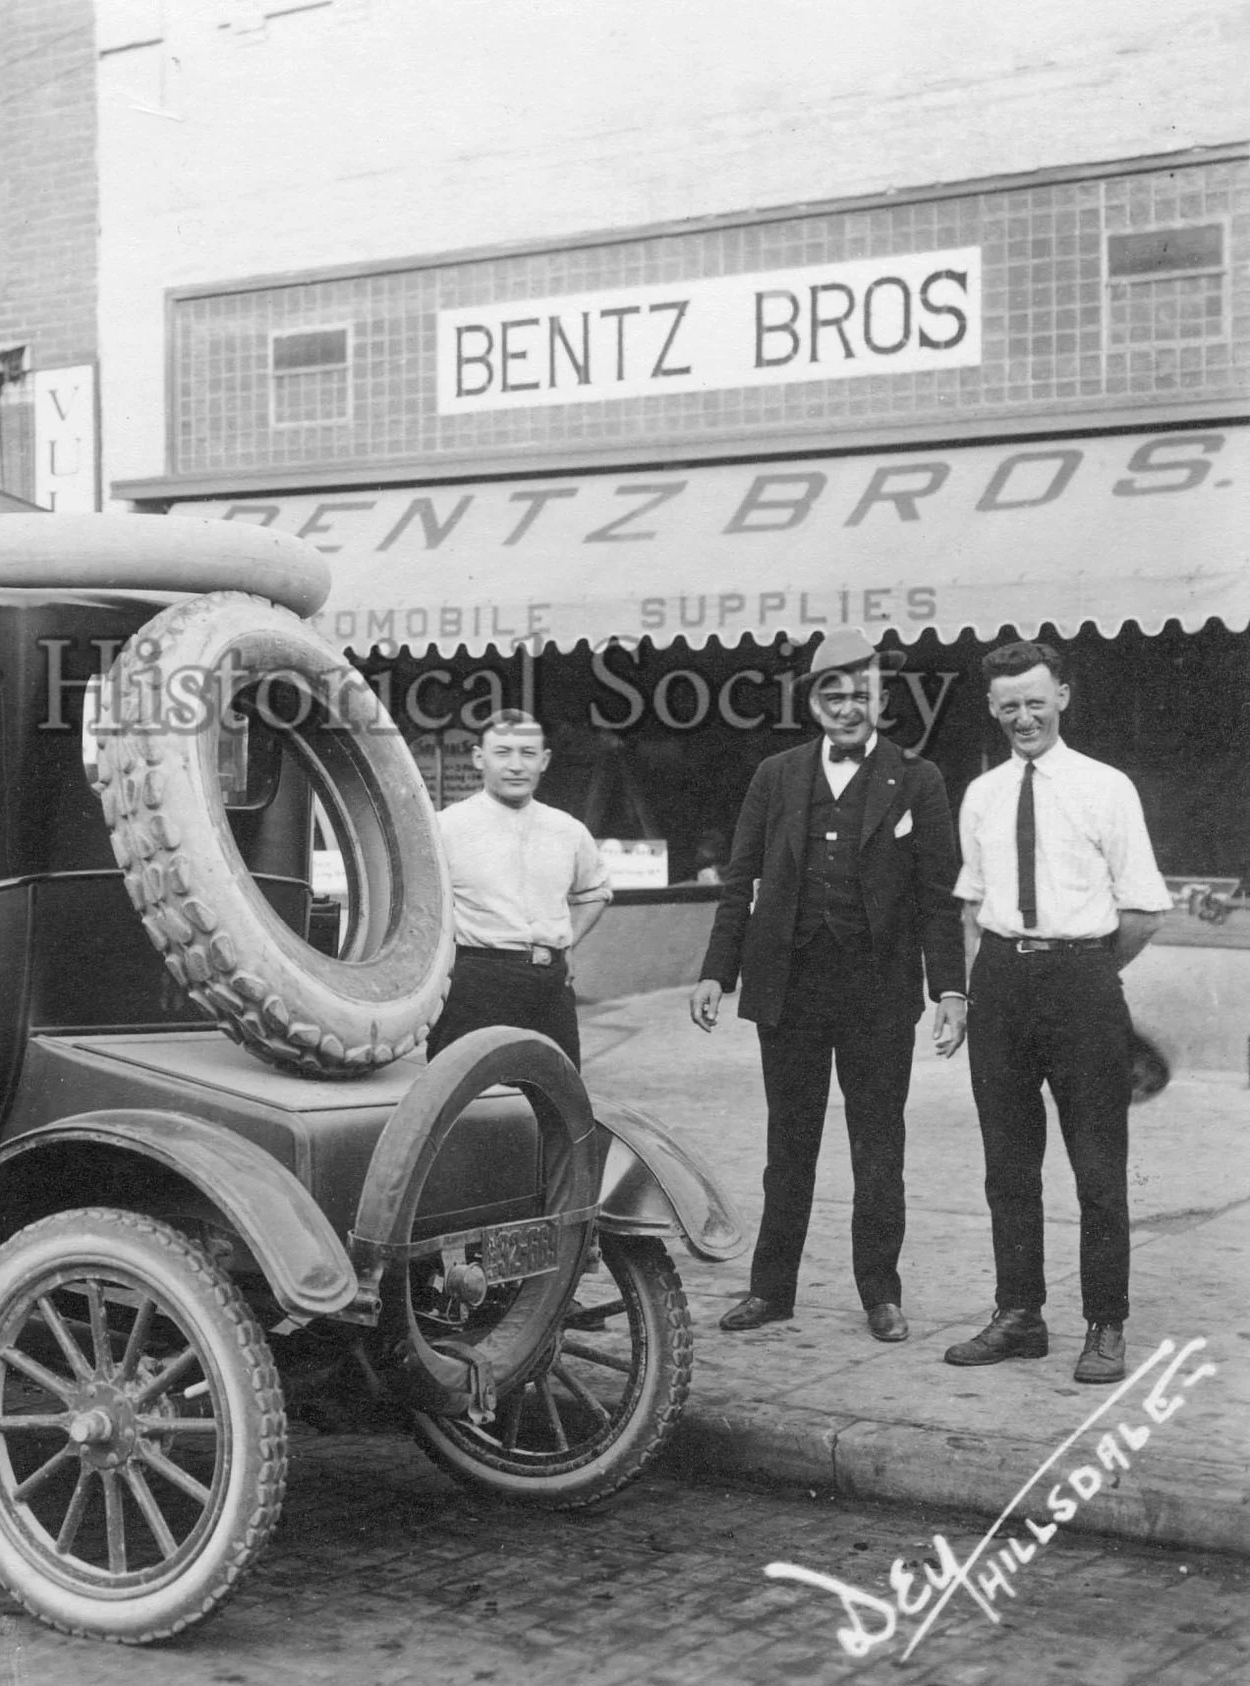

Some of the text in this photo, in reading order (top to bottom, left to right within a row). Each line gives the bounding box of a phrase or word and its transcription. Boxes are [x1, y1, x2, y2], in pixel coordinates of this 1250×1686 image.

[454, 269, 968, 398] BENTZ BROS
[720, 433, 1234, 534] BROS.
[640, 586, 938, 630] SUPPLIES
